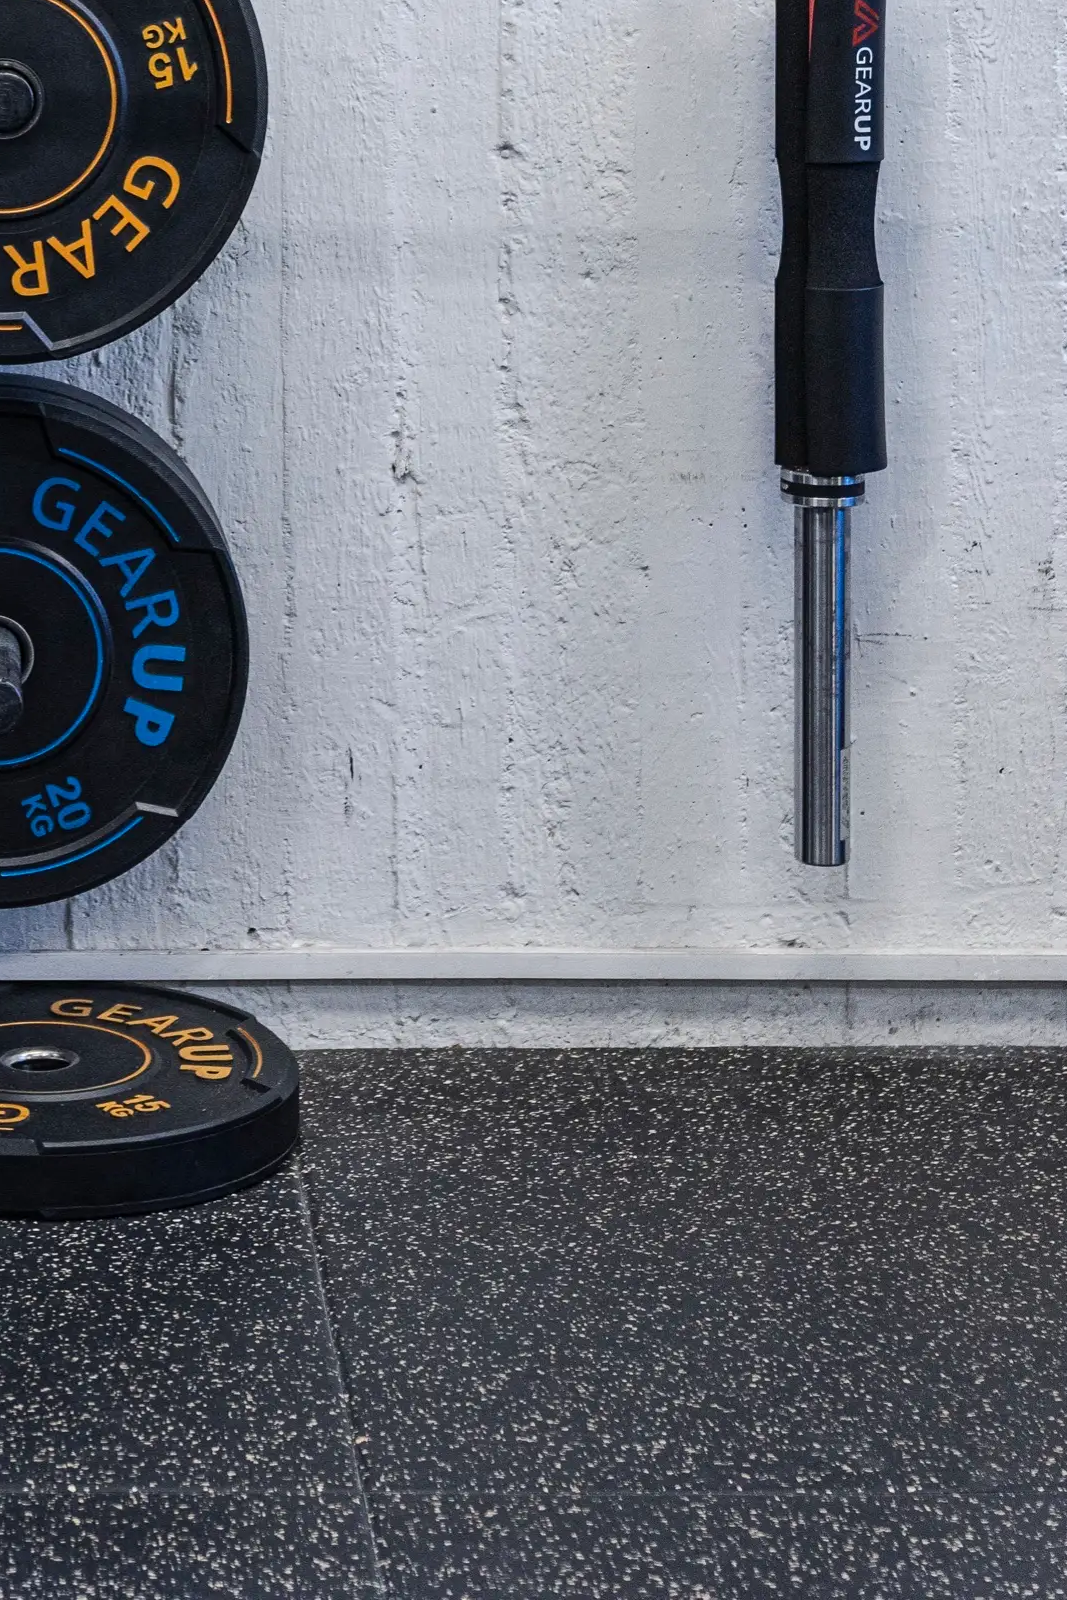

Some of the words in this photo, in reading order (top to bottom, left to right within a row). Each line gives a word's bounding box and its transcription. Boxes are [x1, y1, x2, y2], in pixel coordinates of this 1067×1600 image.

[142, 18, 187, 48] KG
[148, 46, 199, 90] 15
[853, 47, 873, 151] GEARUP
[32, 477, 187, 748] GEARUP
[21, 794, 54, 838] KG
[45, 776, 92, 831] 20
[50, 998, 233, 1082] GEARUP
[95, 1100, 135, 1119] KG
[121, 1093, 171, 1116] 15
